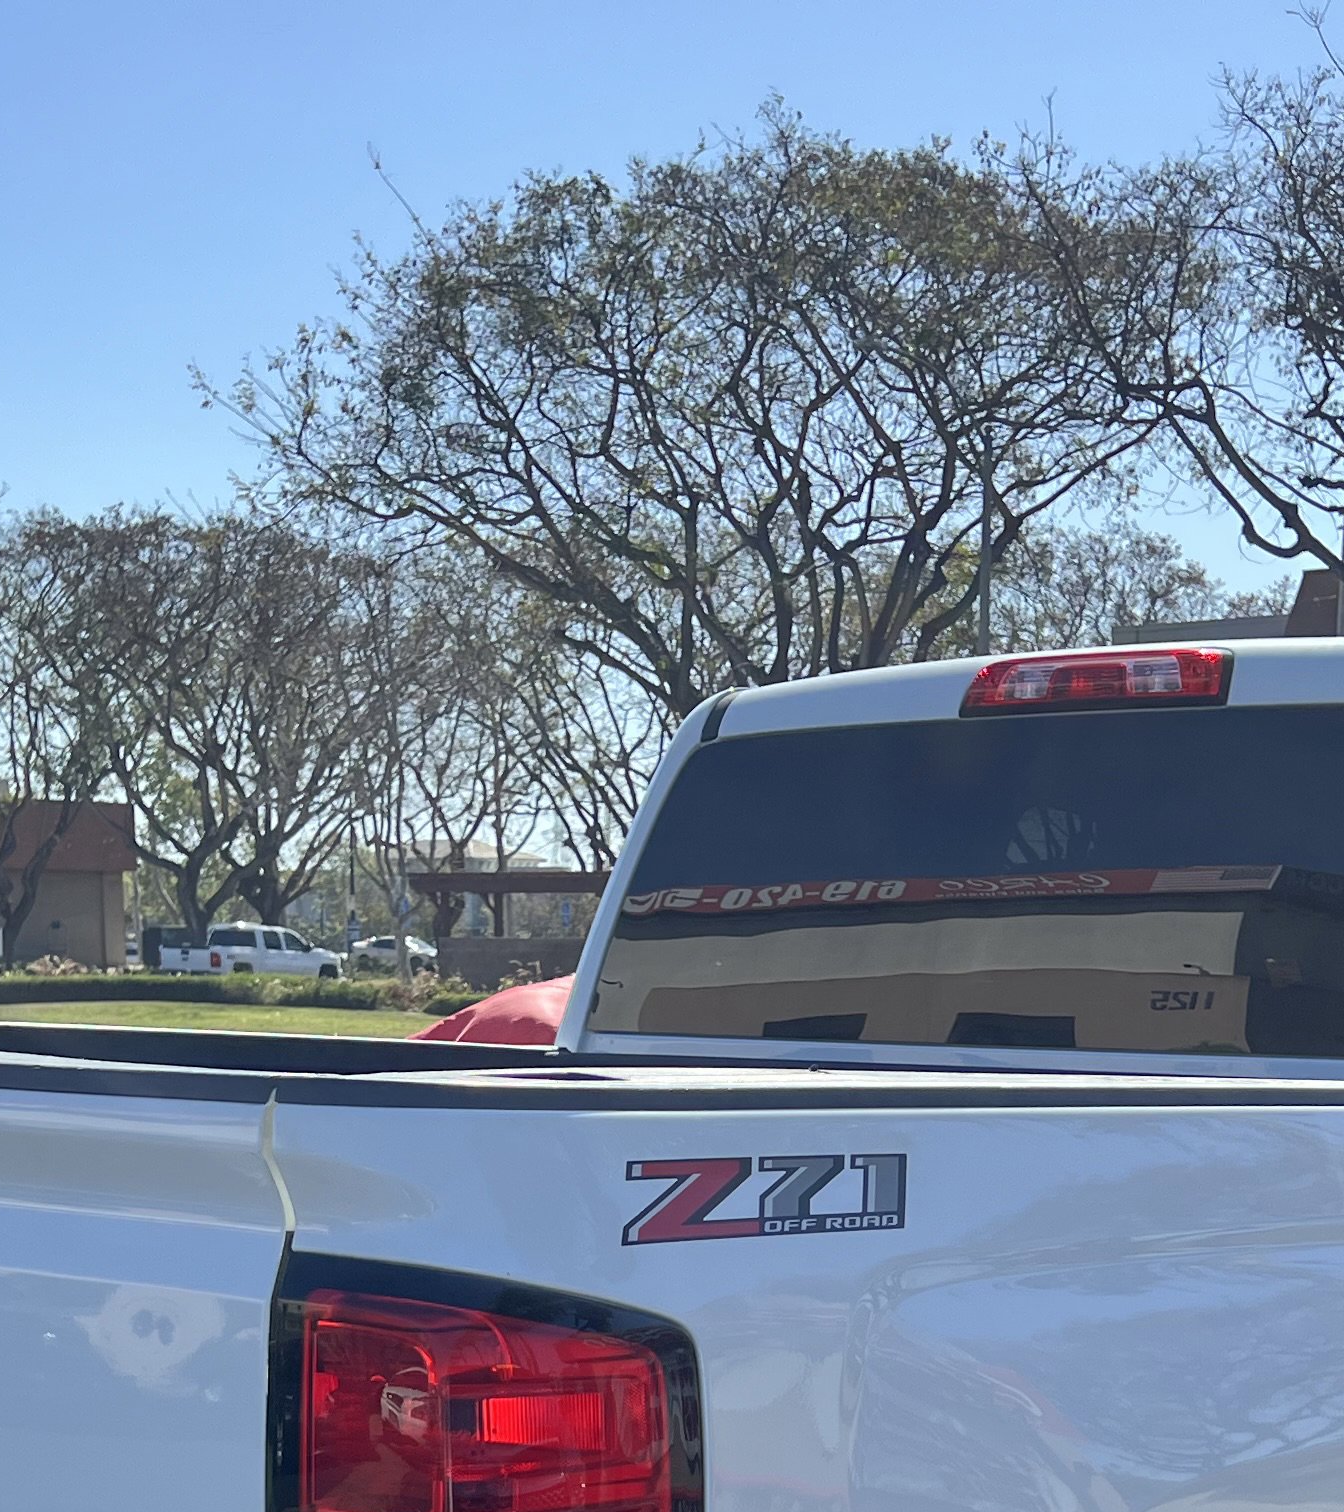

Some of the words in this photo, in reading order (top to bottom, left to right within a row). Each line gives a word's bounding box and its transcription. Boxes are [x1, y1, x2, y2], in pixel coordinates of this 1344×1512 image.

[622, 1153, 907, 1246] Z71
[763, 1219, 818, 1233] OFF
[825, 1214, 899, 1230] ROAD
